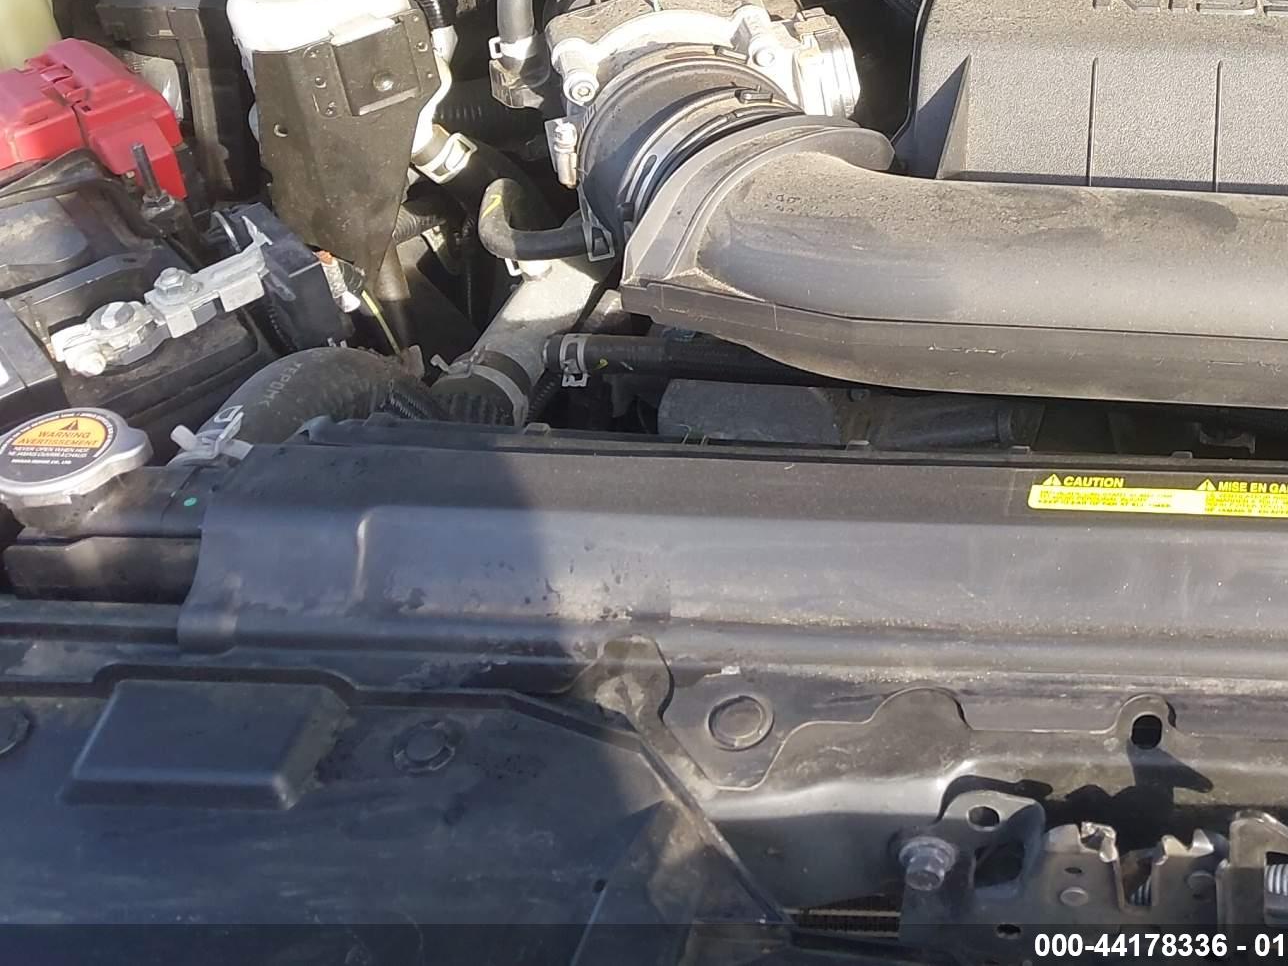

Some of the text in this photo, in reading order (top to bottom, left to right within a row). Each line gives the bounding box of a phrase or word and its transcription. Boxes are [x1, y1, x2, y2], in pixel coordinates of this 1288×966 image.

[38, 431, 92, 439] WARNING
[18, 438, 99, 446] AVERTISSEMENT
[1063, 475, 1124, 488] CAUTION
[1218, 481, 1247, 492] MISE
[1250, 482, 1267, 493] EN
